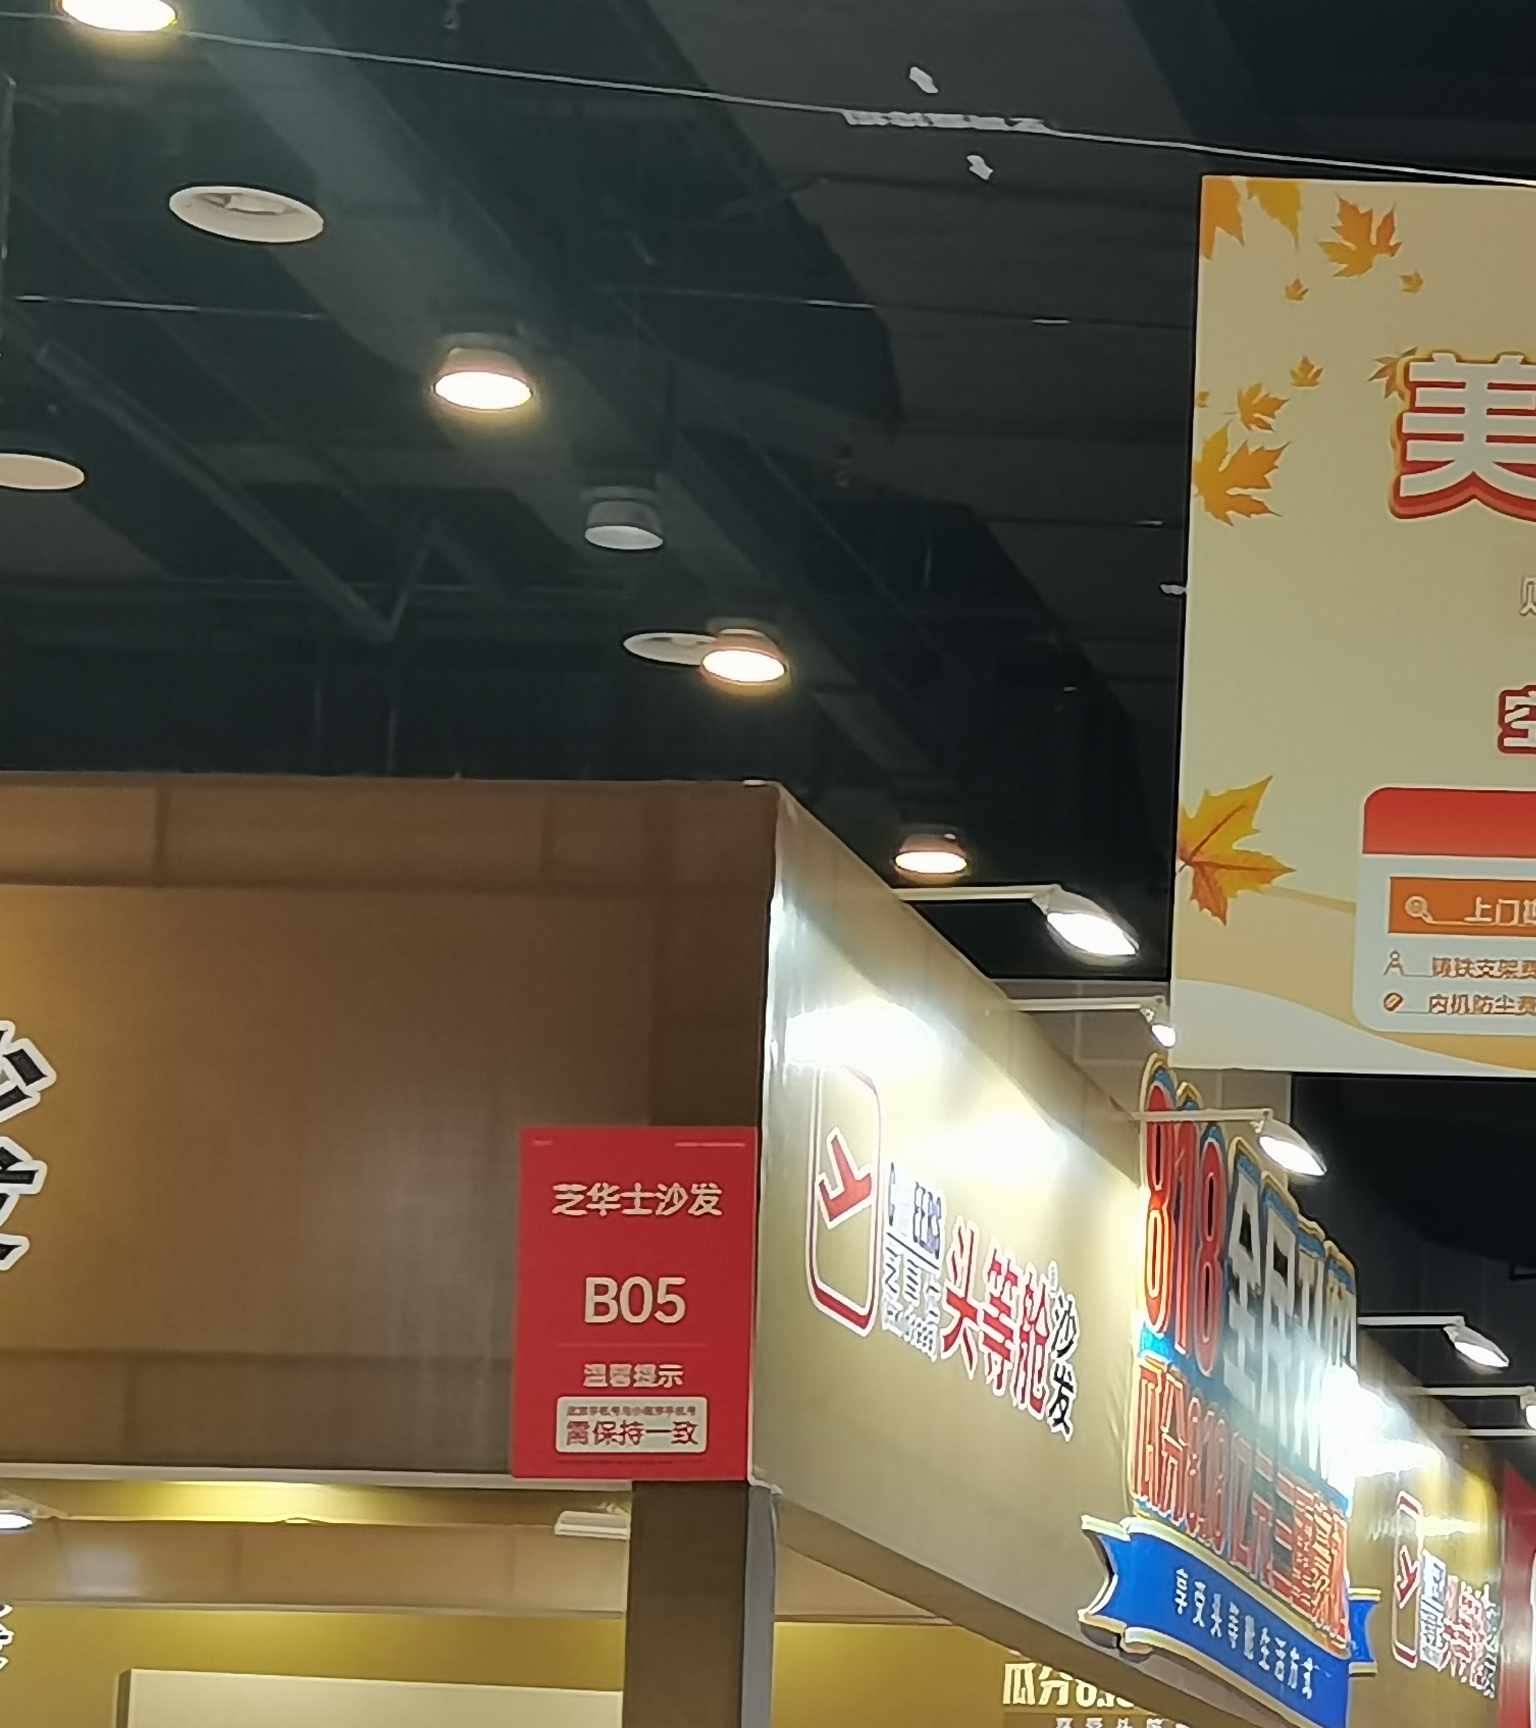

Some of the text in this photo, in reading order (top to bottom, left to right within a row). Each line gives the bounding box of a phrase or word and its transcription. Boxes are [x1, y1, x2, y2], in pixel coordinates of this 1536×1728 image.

[551, 1182, 724, 1218] 芝华士沙发
[583, 1275, 687, 1325] B05
[940, 1214, 1050, 1421] 头等舱
[582, 1363, 685, 1389] 温馨提示
[565, 1419, 699, 1446] 需保持一致
